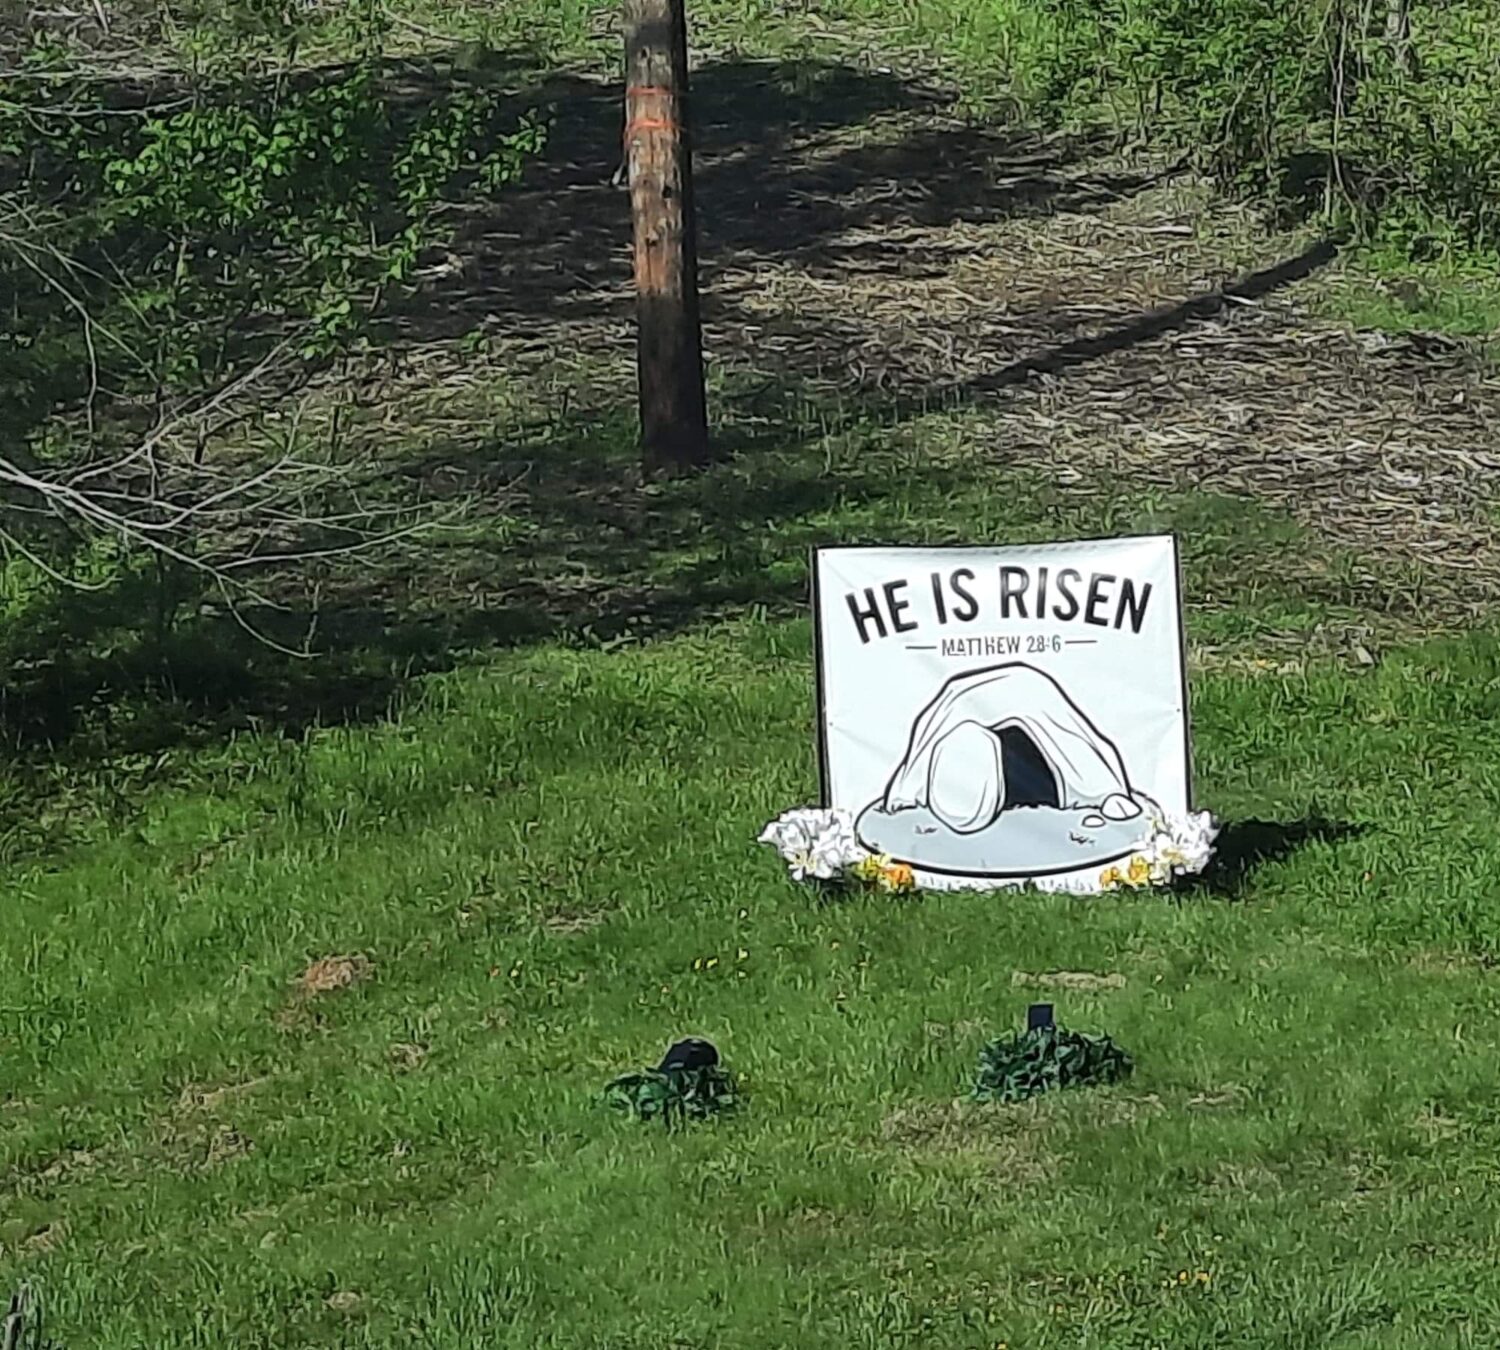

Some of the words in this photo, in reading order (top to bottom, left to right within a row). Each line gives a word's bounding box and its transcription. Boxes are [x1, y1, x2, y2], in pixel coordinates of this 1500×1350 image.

[844, 578, 918, 644] HE
[930, 567, 979, 625] IS
[999, 565, 1154, 634] RISEN
[941, 636, 1021, 656] MATTHEW
[1026, 634, 1061, 653] 28:6
